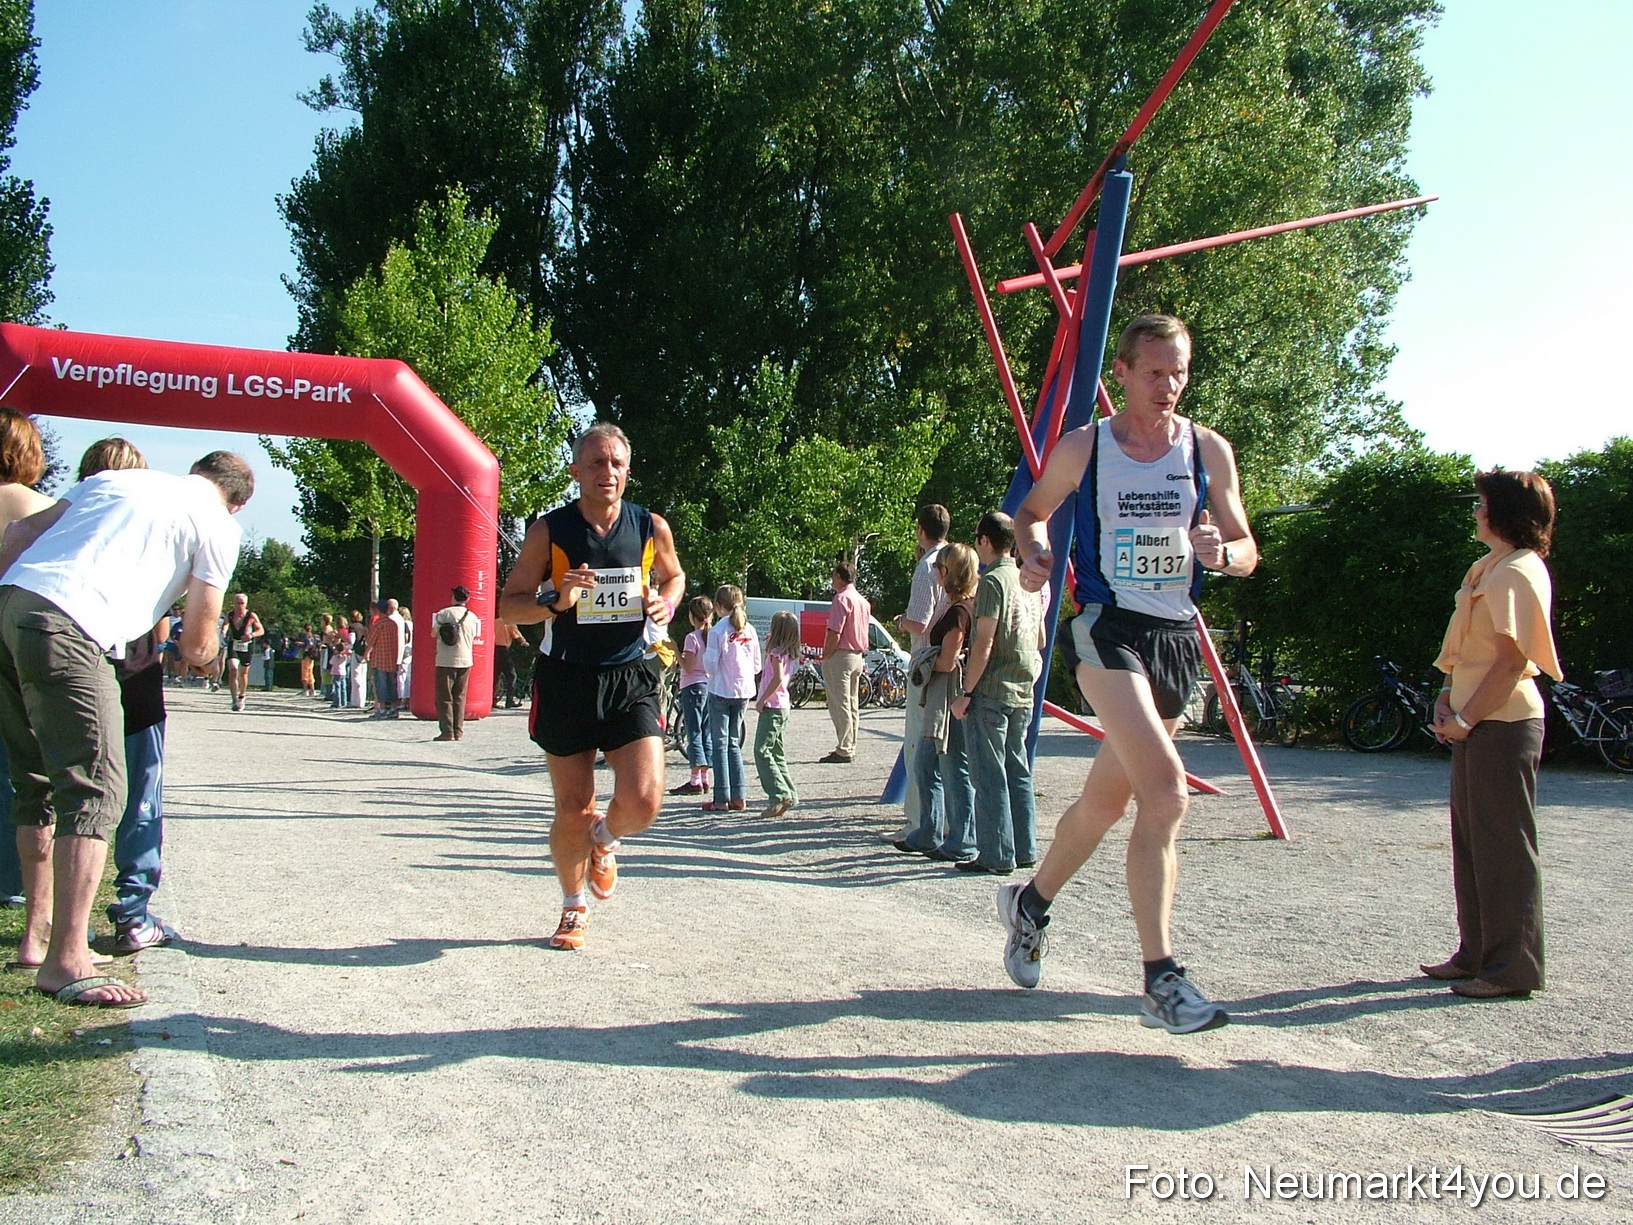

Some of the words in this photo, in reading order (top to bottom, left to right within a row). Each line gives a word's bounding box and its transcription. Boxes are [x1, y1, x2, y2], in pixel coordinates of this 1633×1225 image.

[51, 357, 219, 399] Verpflegung
[227, 373, 353, 403] LGS-Park
[1118, 490, 1180, 501] Lebenshilfe
[1118, 501, 1182, 511] Werkstätten
[1135, 535, 1170, 546] Albert
[1119, 552, 1128, 562] A
[1136, 555, 1185, 575] 3137
[581, 590, 588, 599] B
[595, 591, 628, 608] 416
